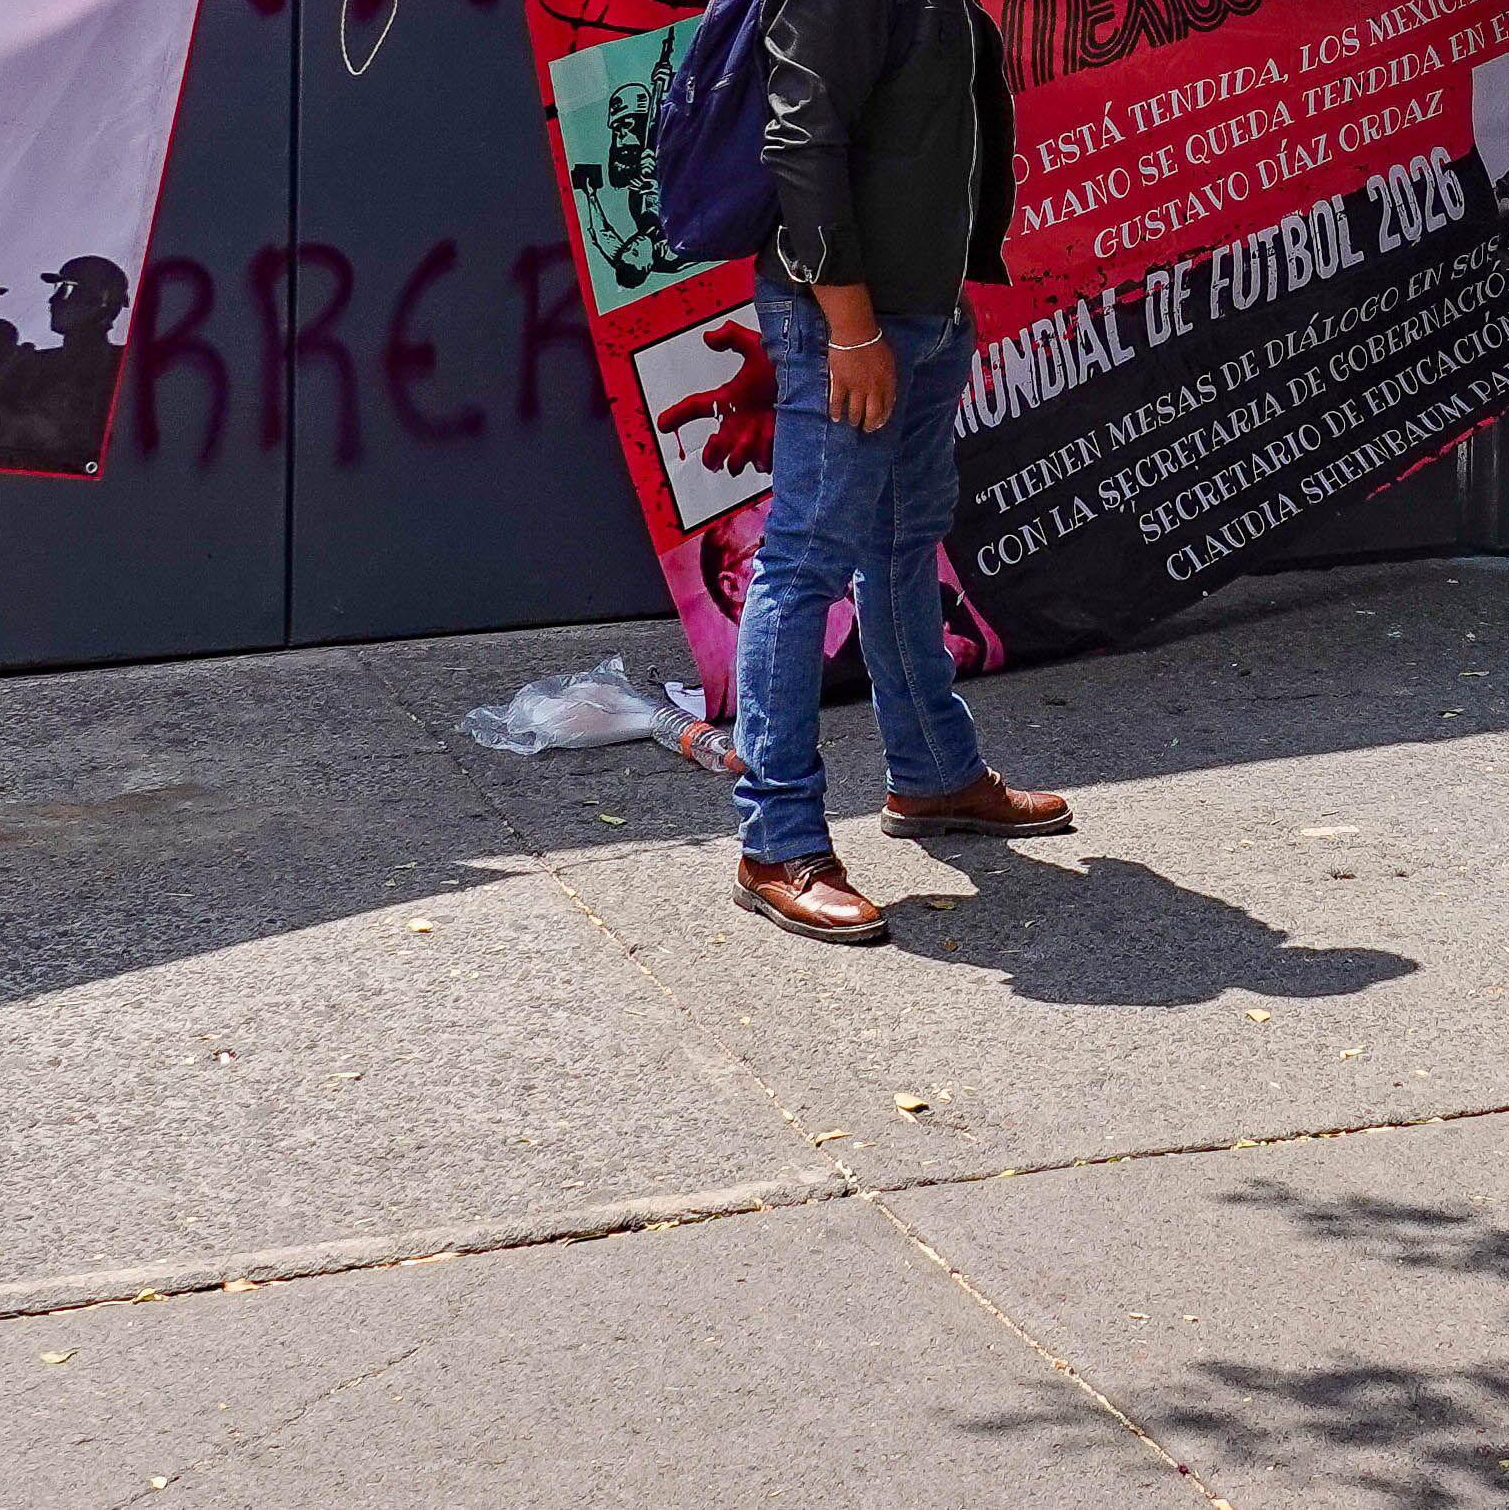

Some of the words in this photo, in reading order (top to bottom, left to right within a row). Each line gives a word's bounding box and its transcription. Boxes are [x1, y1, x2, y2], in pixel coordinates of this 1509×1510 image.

[1021, 167, 1131, 236] MANO
[1138, 145, 1180, 187] SE
[1185, 100, 1295, 166] QUEDA
[1301, 44, 1445, 118] TENDIDA
[1448, 23, 1486, 64] EN
[1036, 100, 1127, 174] ESTÁ
[1127, 57, 1289, 134] TENDIDA,
[1299, 24, 1361, 74] LOS
[1093, 171, 1250, 259] GUSTAVO
[1256, 138, 1333, 190] DÍAZ
[1339, 89, 1445, 153] ORDAZ
[1145, 257, 1195, 349] DE
[1209, 193, 1365, 320] FUTBOL
[1366, 146, 1466, 253] 2026
[1105, 371, 1217, 451] MESAS
[1219, 350, 1260, 391] DE
[1263, 286, 1399, 370] DIÁLOGO
[1406, 262, 1445, 302] EN
[976, 516, 1049, 577] CON
[1048, 494, 1098, 538] LA
[1098, 392, 1287, 512] SECRETARIA
[1286, 367, 1327, 407] DE
[1139, 423, 1322, 545] SECRETARIO
[1321, 398, 1366, 439] DE
[1166, 492, 1303, 582] CLAUDIA
[1300, 393, 1475, 504] SHEINBAUM
